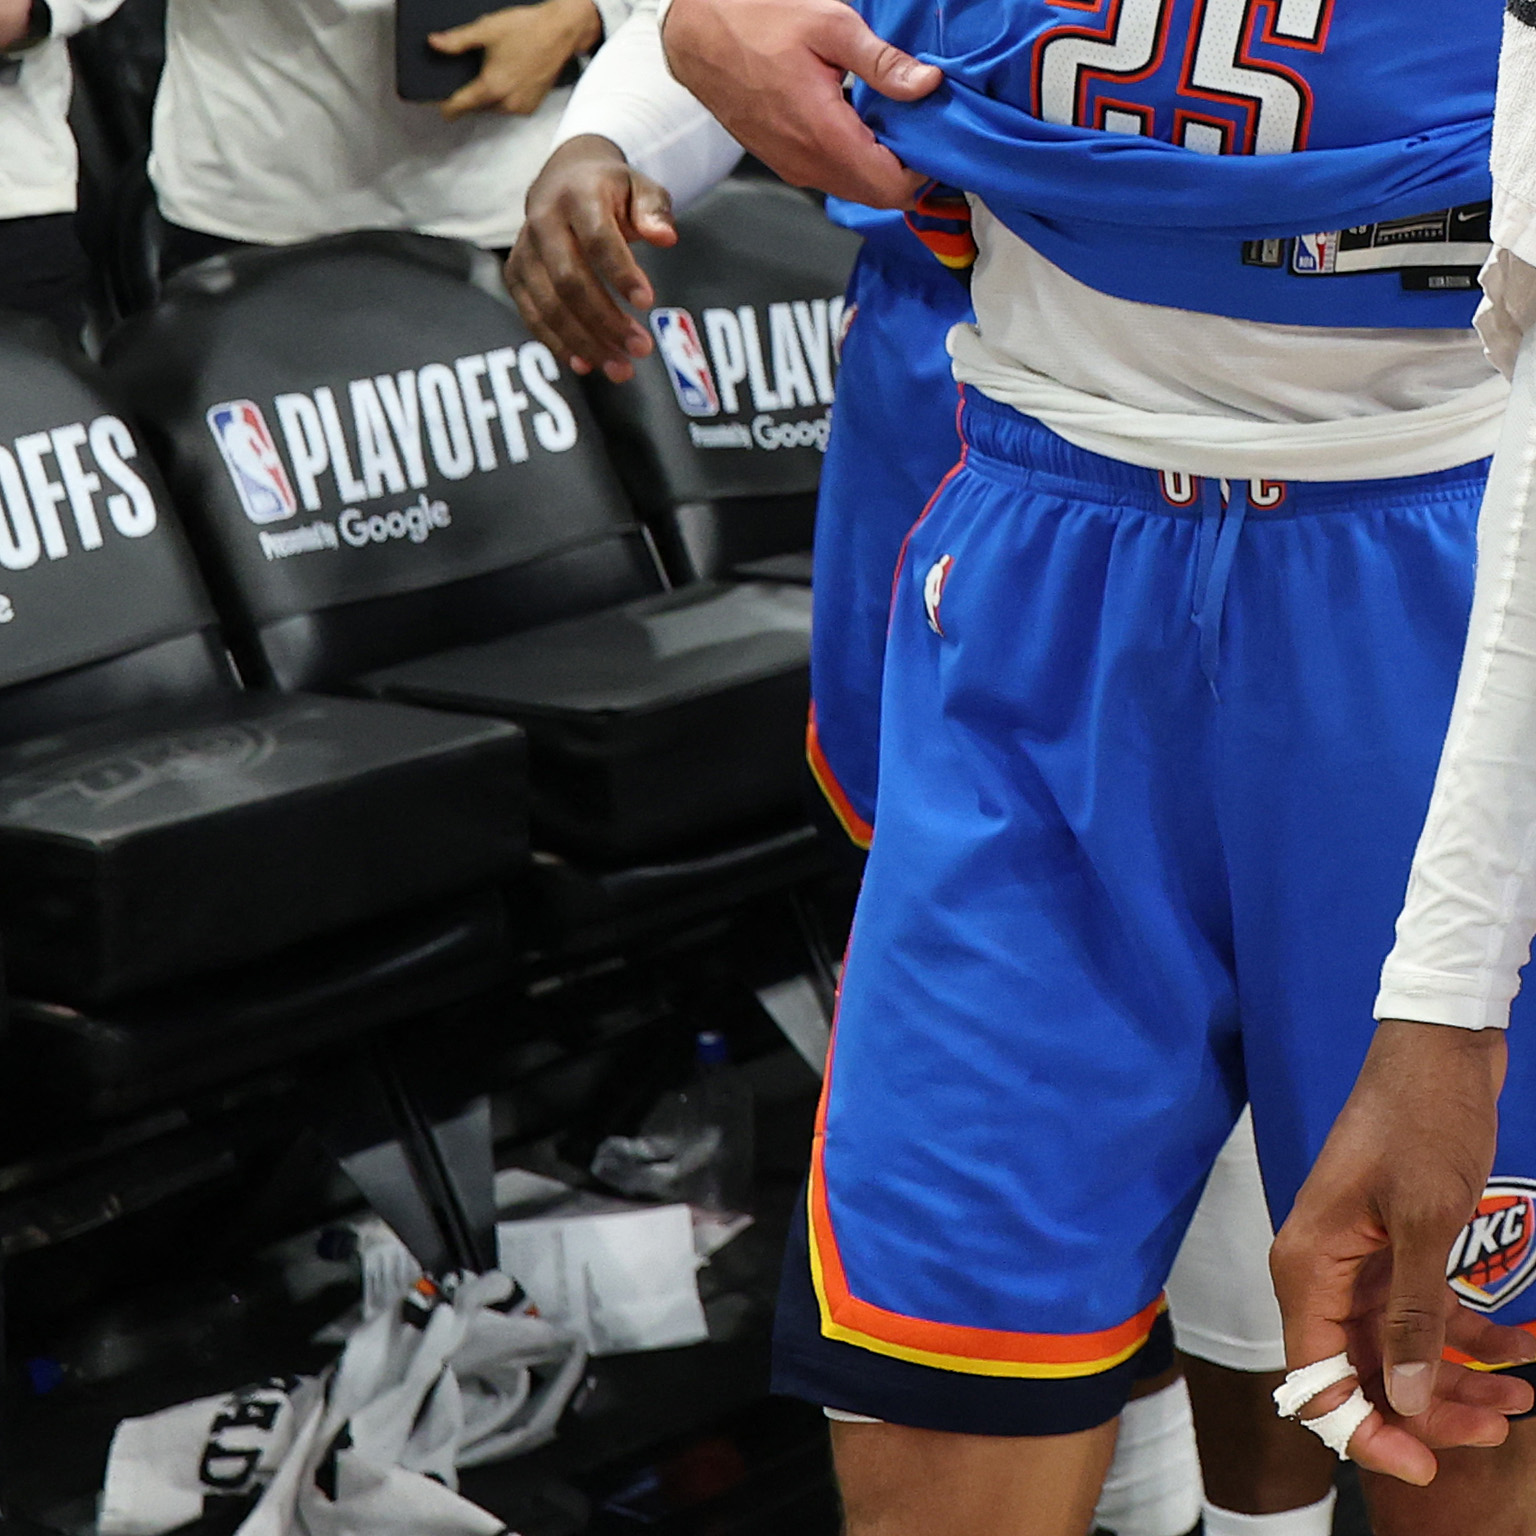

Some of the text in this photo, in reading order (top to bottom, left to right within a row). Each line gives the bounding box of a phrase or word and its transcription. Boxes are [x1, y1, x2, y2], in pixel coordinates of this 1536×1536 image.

[273, 340, 577, 511] PLAYOFFS
[751, 408, 833, 453] Goog
[338, 493, 452, 547] Google
